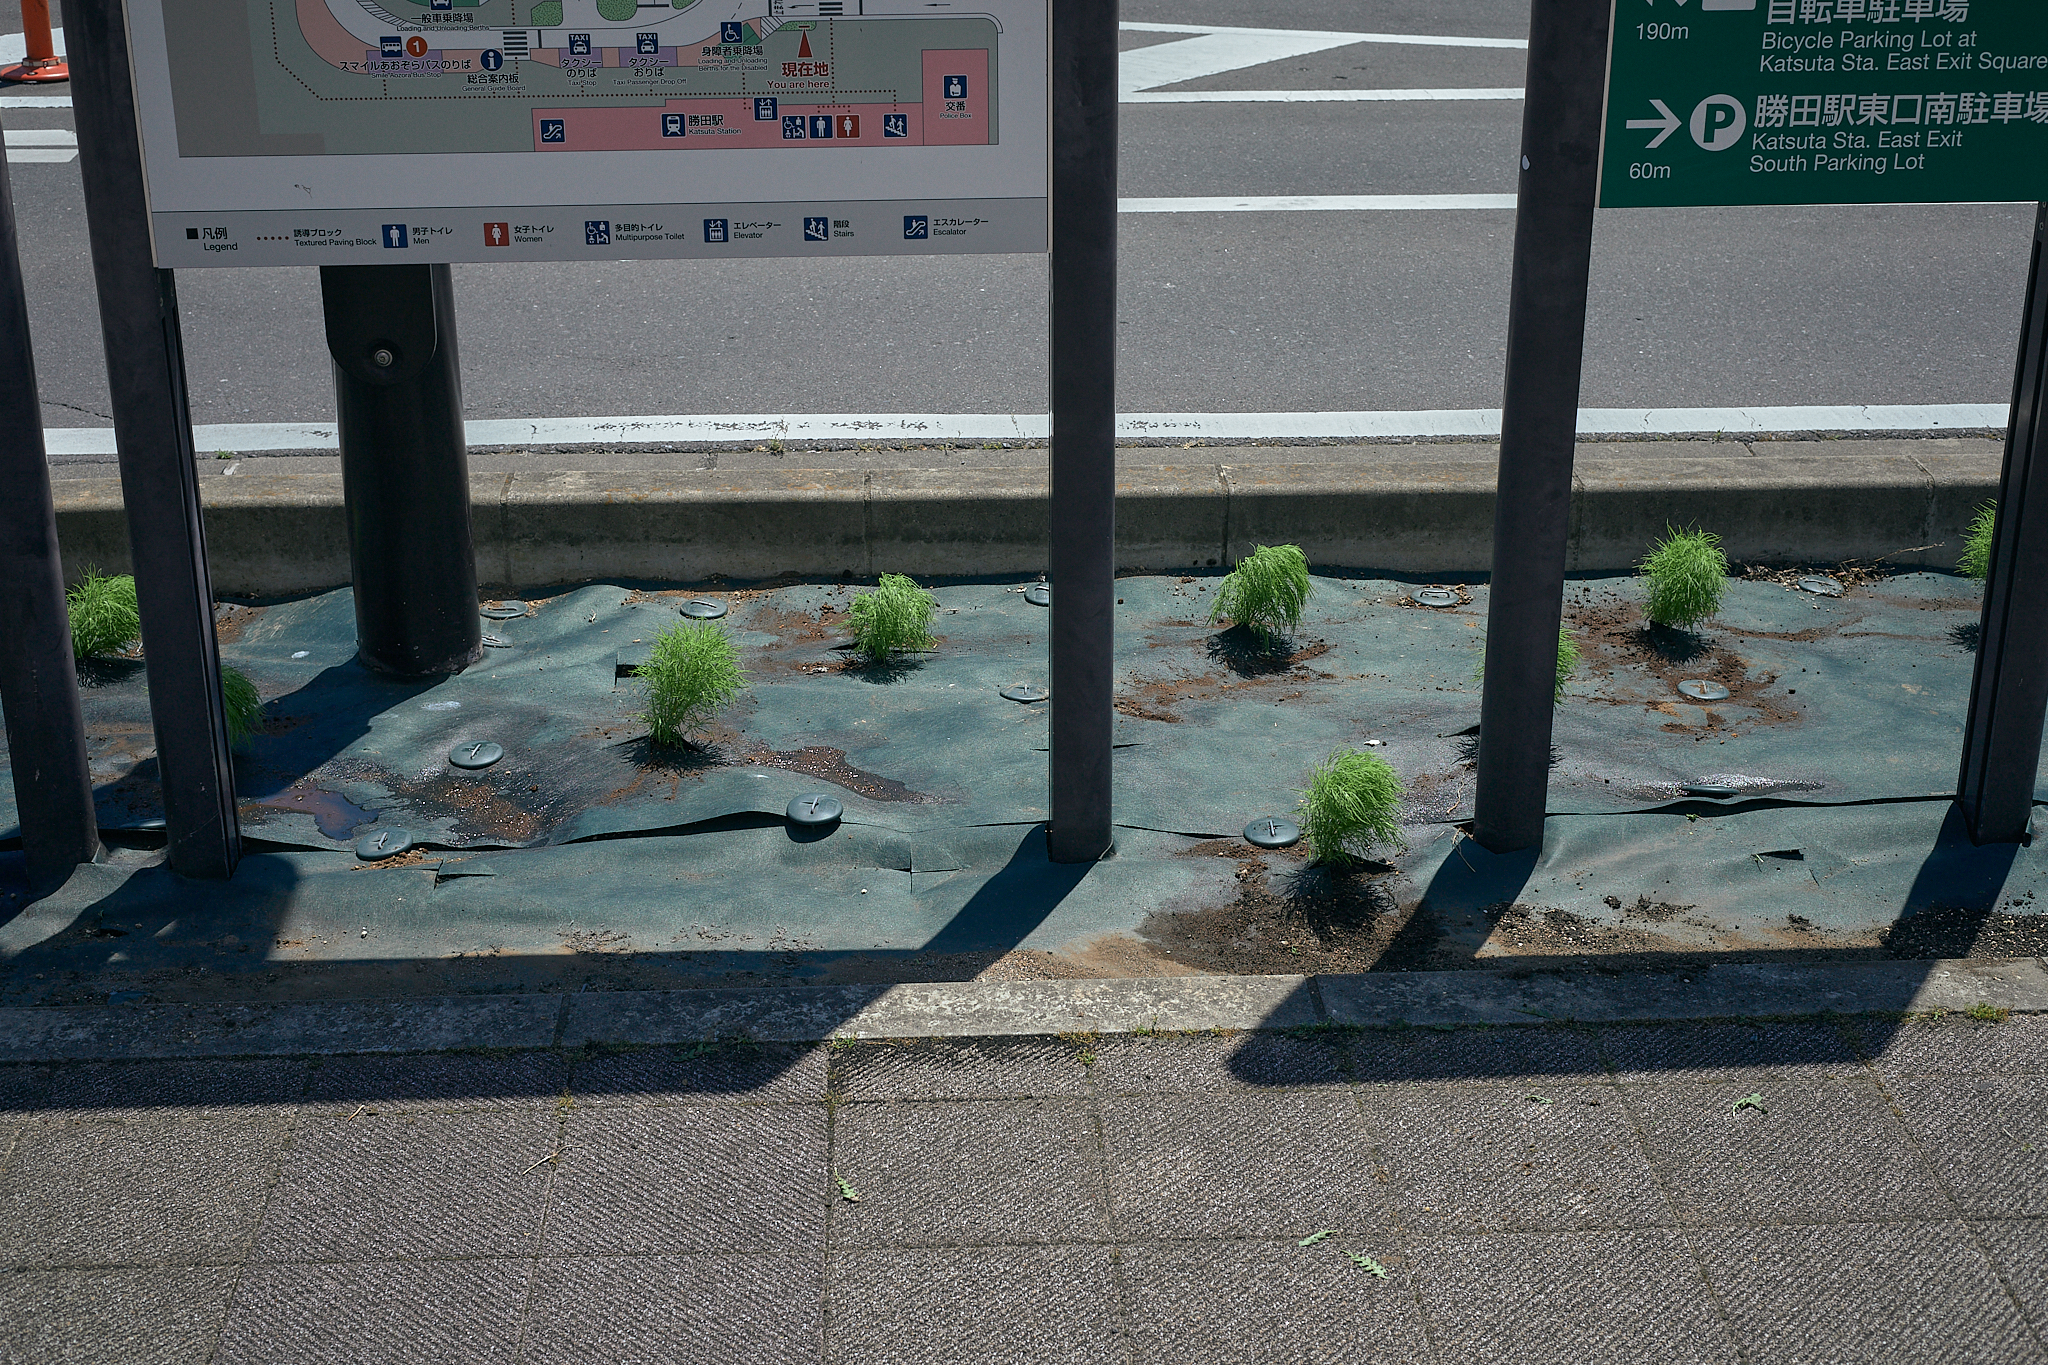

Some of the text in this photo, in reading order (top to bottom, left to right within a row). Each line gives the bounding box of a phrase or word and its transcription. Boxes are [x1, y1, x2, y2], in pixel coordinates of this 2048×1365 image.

[1767, 0, 1969, 24] 自転車駐車場
[411, 13, 474, 23] 一般車乗降場
[1637, 23, 1689, 39] 190m
[1762, 30, 1977, 53] Bicycle Parking Lot at
[412, 41, 420, 53] 1
[702, 46, 763, 56] 身障者乗降場
[339, 60, 471, 71] スマイルあおぞらバスのりば
[561, 59, 602, 68] タクシー
[629, 58, 669, 67] タクシー
[1760, 52, 2048, 73] Katsuta Sta. East Exit Square
[567, 68, 597, 78] のりば
[634, 67, 664, 77] おりば
[782, 62, 829, 77] 現在地
[467, 74, 519, 84] 総合案内板
[767, 81, 786, 89] You
[807, 80, 830, 88] here
[945, 101, 966, 111] 交番
[1753, 91, 2048, 128] 勝田駅東口南駐車場
[688, 115, 724, 126] 勝田駅
[1752, 130, 1963, 150] Katsuta Sta. East Exit
[1750, 153, 1925, 175] South Parking Lot
[1629, 163, 1671, 179] 60m
[833, 220, 850, 229] 階段
[933, 218, 989, 227] エスカレーター
[412, 227, 452, 235] 男子トイレ
[514, 225, 554, 234] 女子トイレ
[615, 224, 663, 232] 多目的トイレ
[933, 228, 967, 236] Escalator
[202, 227, 228, 240] 凡例
[294, 229, 342, 238] 誘導ブロック
[615, 234, 663, 242] Multipurpose
[833, 230, 855, 238] Stairs
[295, 238, 377, 248] Textured Paving Block
[413, 237, 430, 245] Men
[514, 235, 543, 243] Women
[203, 242, 238, 252] Legend
